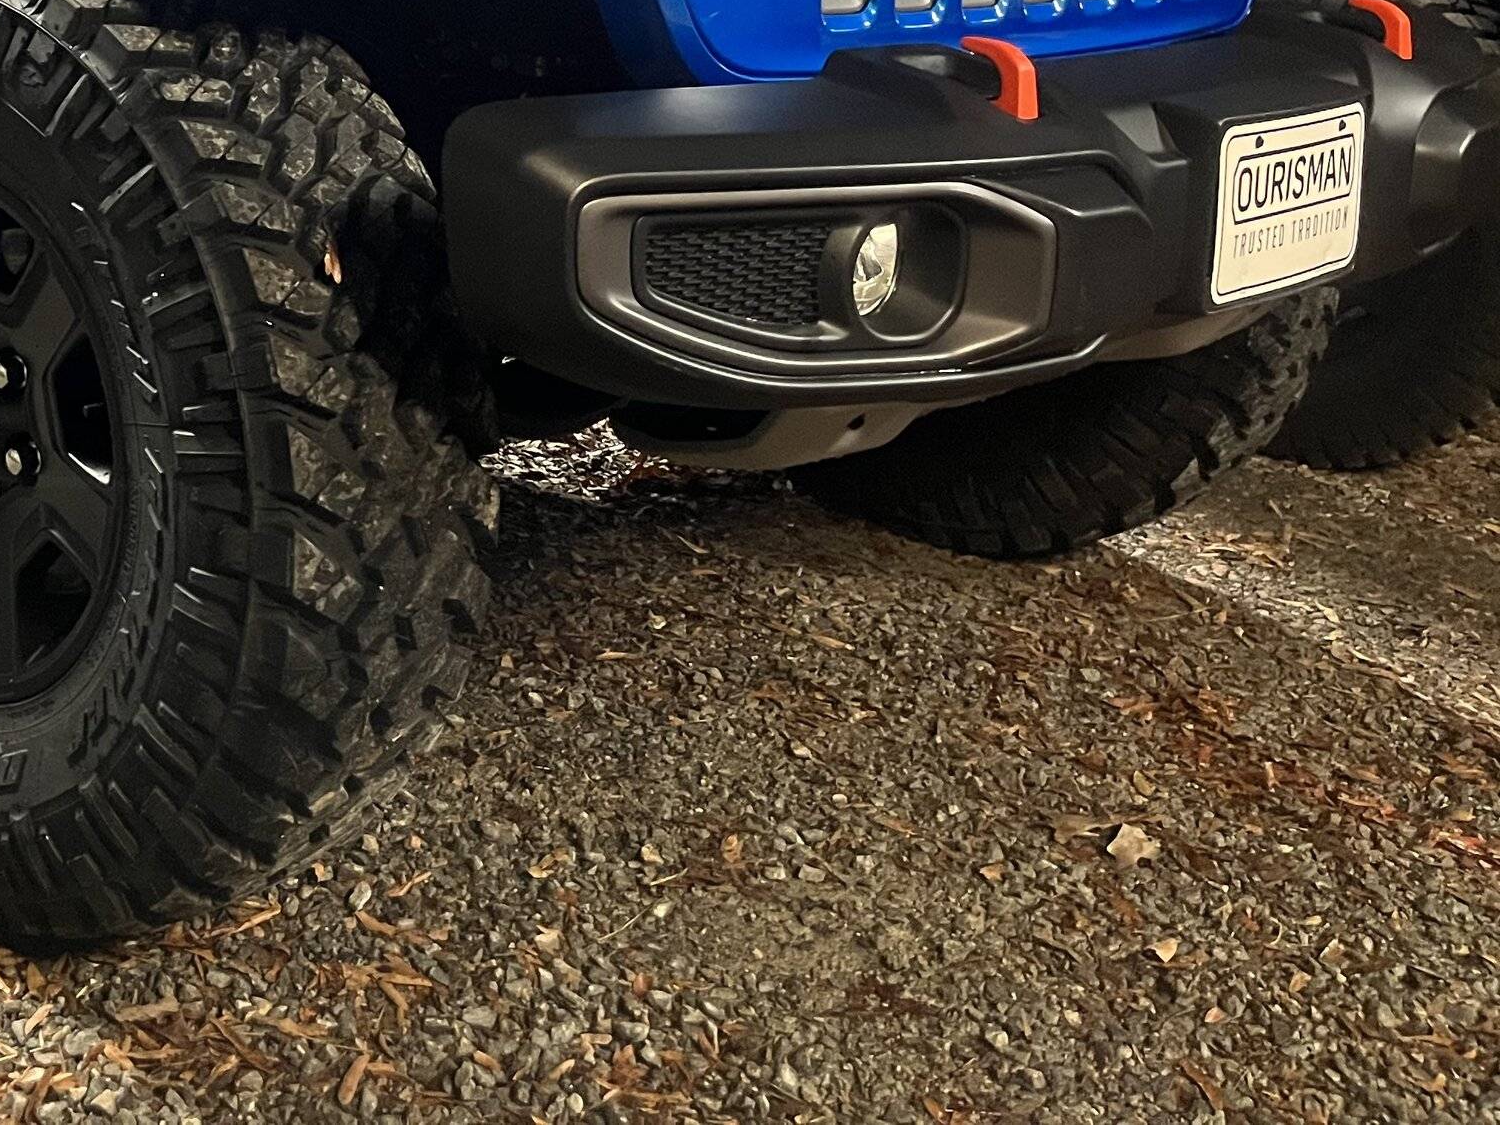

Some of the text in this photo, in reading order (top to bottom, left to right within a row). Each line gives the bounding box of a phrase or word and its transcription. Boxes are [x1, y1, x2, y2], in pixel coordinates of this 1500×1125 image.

[1237, 145, 1352, 212] OURISMAN
[1233, 206, 1349, 258] TRUSTED TRADITION
